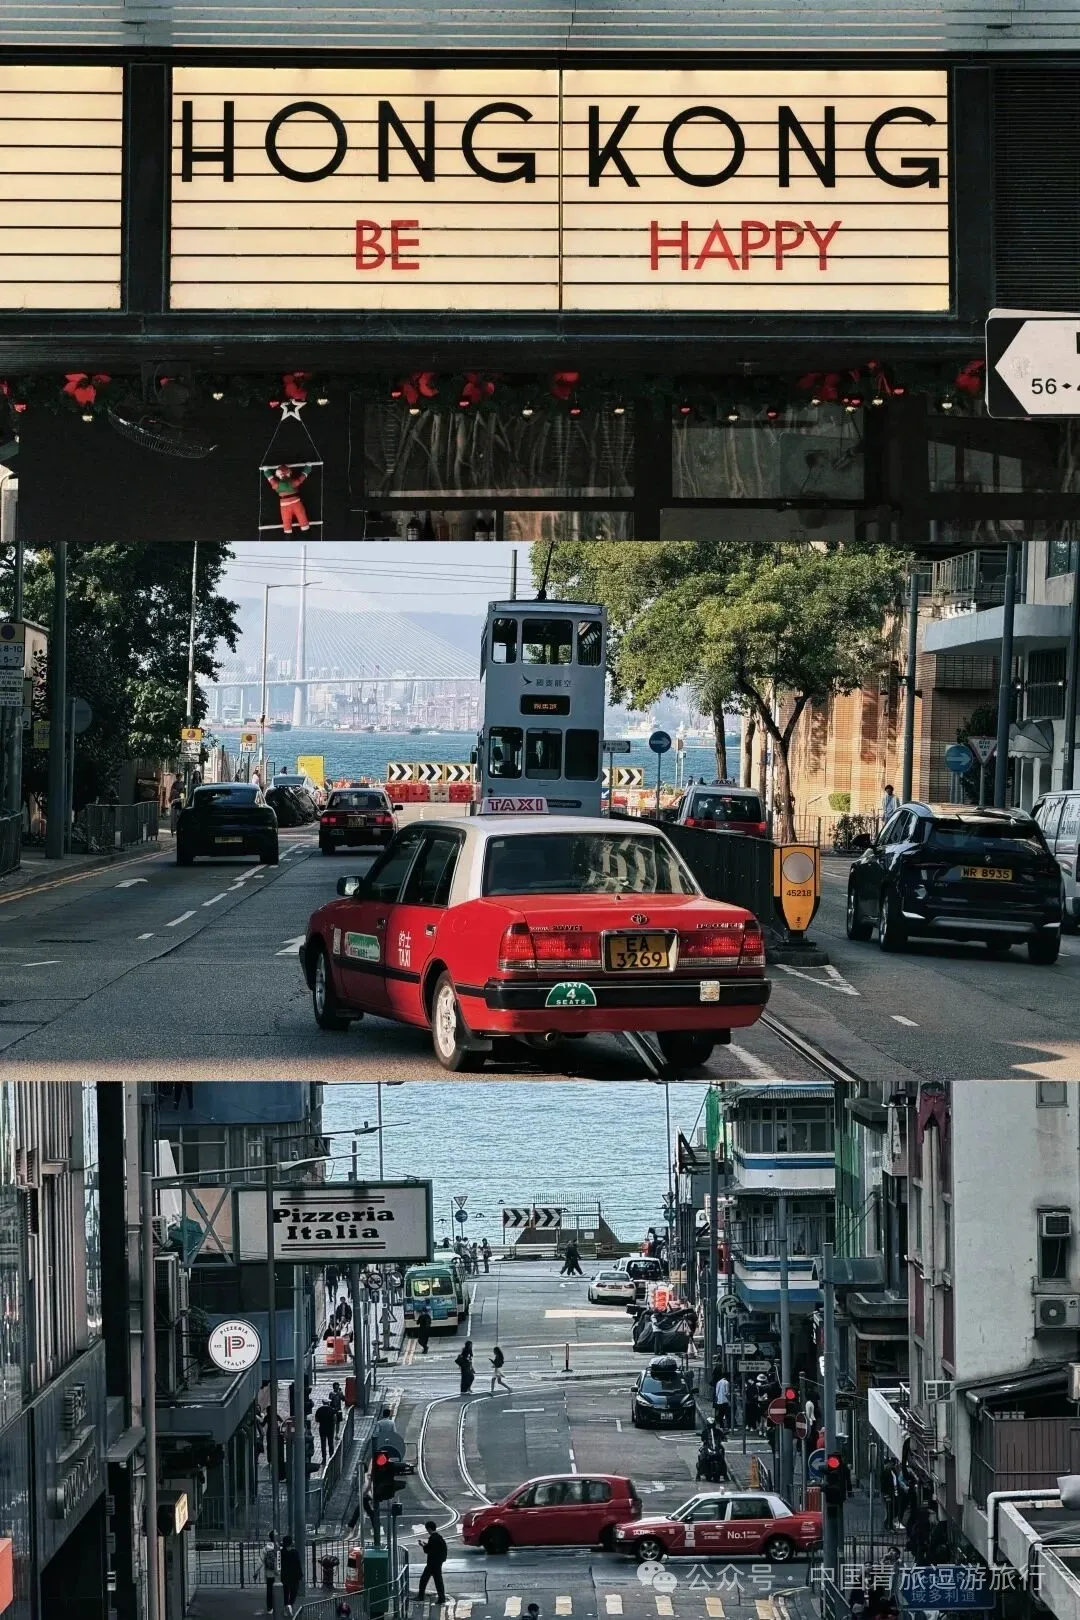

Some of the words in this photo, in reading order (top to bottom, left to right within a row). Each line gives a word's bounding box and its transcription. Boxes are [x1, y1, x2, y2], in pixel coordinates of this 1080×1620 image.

[181, 100, 536, 183] HONG
[588, 105, 940, 189] KONG
[355, 219, 420, 271] BE
[649, 219, 842, 271] HAPPY
[1031, 378, 1057, 395] 56
[488, 799, 544, 811] TAXI
[962, 867, 977, 878] WR
[981, 868, 1010, 879] 8935
[786, 889, 812, 897] 45218
[626, 936, 650, 953] EA
[616, 951, 663, 968] 3269
[566, 988, 577, 999] 4
[273, 1206, 395, 1224] Pizzeria
[287, 1224, 380, 1240] Italia
[220, 1325, 248, 1335] PIZZERIA
[223, 1359, 246, 1367] ITALIA
